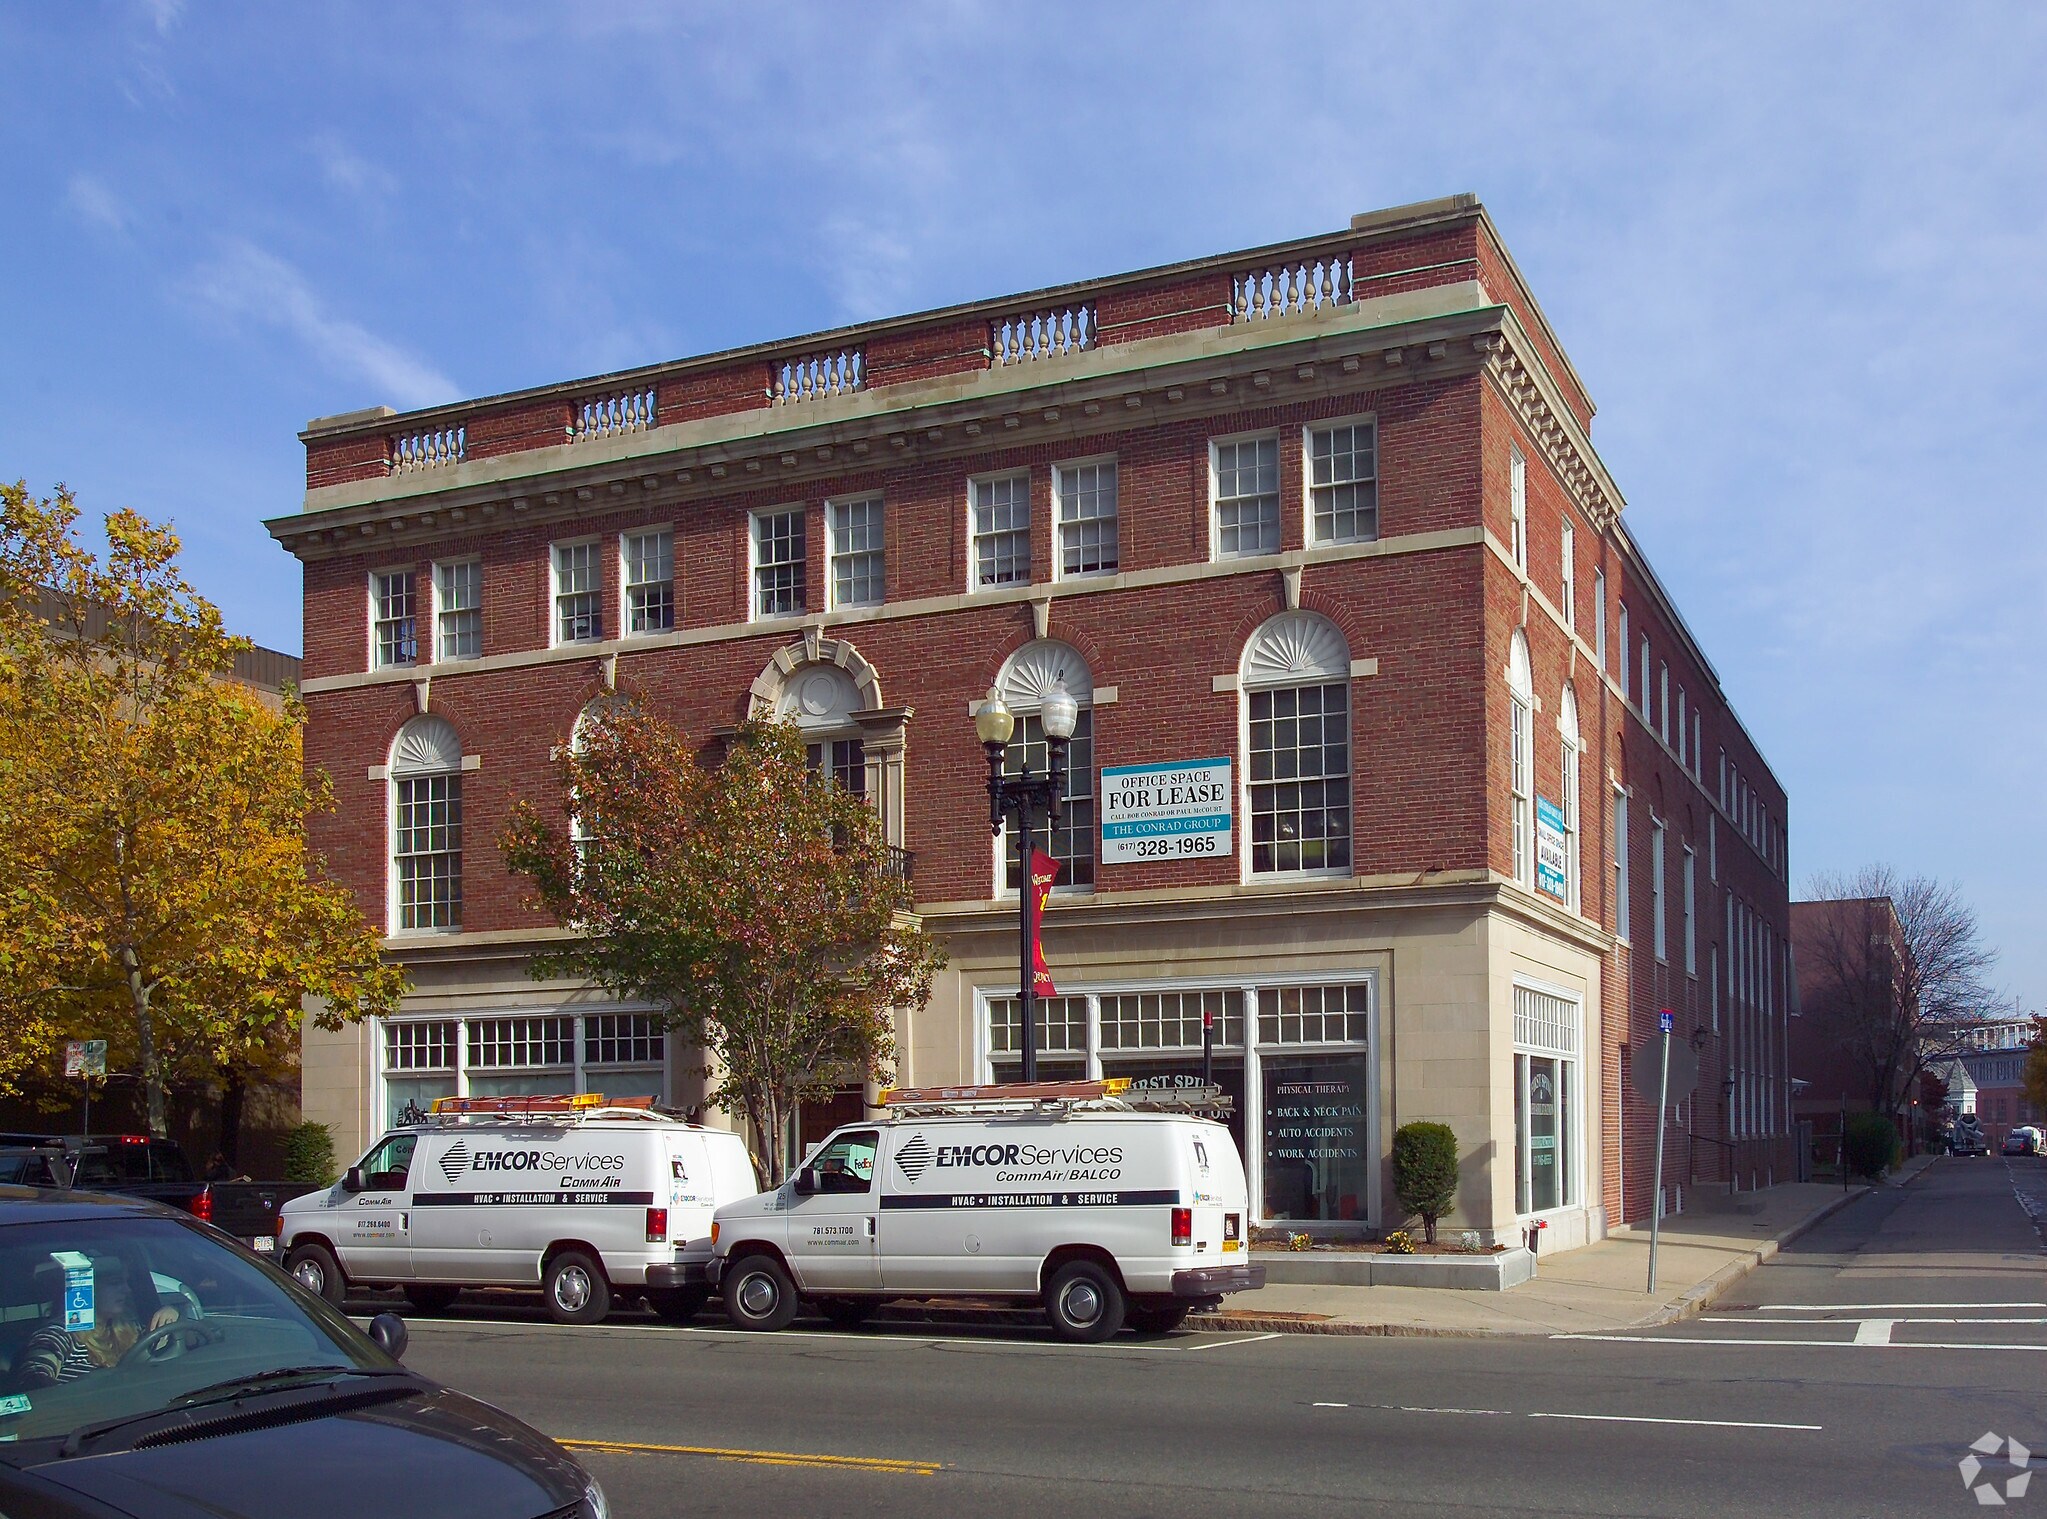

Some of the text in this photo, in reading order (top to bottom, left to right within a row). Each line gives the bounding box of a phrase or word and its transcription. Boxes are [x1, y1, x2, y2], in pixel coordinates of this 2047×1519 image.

[1122, 771, 1211, 788] OFFICE SPACE
[1109, 784, 1224, 809] FOR LEASE
[1141, 810, 1165, 818] CONRAD
[1113, 818, 1221, 835] THE CONRAD GROUP
[1118, 836, 1215, 856] (617) 328-1965
[1277, 1085, 1350, 1095] PHYSICAL THERAPY
[1277, 1106, 1361, 1117] BACK & NECK PAIN
[1278, 1127, 1354, 1138] AUTO ACCIDENTS
[1278, 1148, 1357, 1159] WORK ACCIDENTS
[855, 1158, 872, 1170] FedEx
[996, 1168, 1121, 1182] CommAir/BALCO
[474, 1193, 608, 1203] HVAC INSTALLATION & SERVICE
[951, 1193, 1118, 1206] HVAC INSTALLATION & SERVICE
[813, 1227, 854, 1235] 781.573.1700
